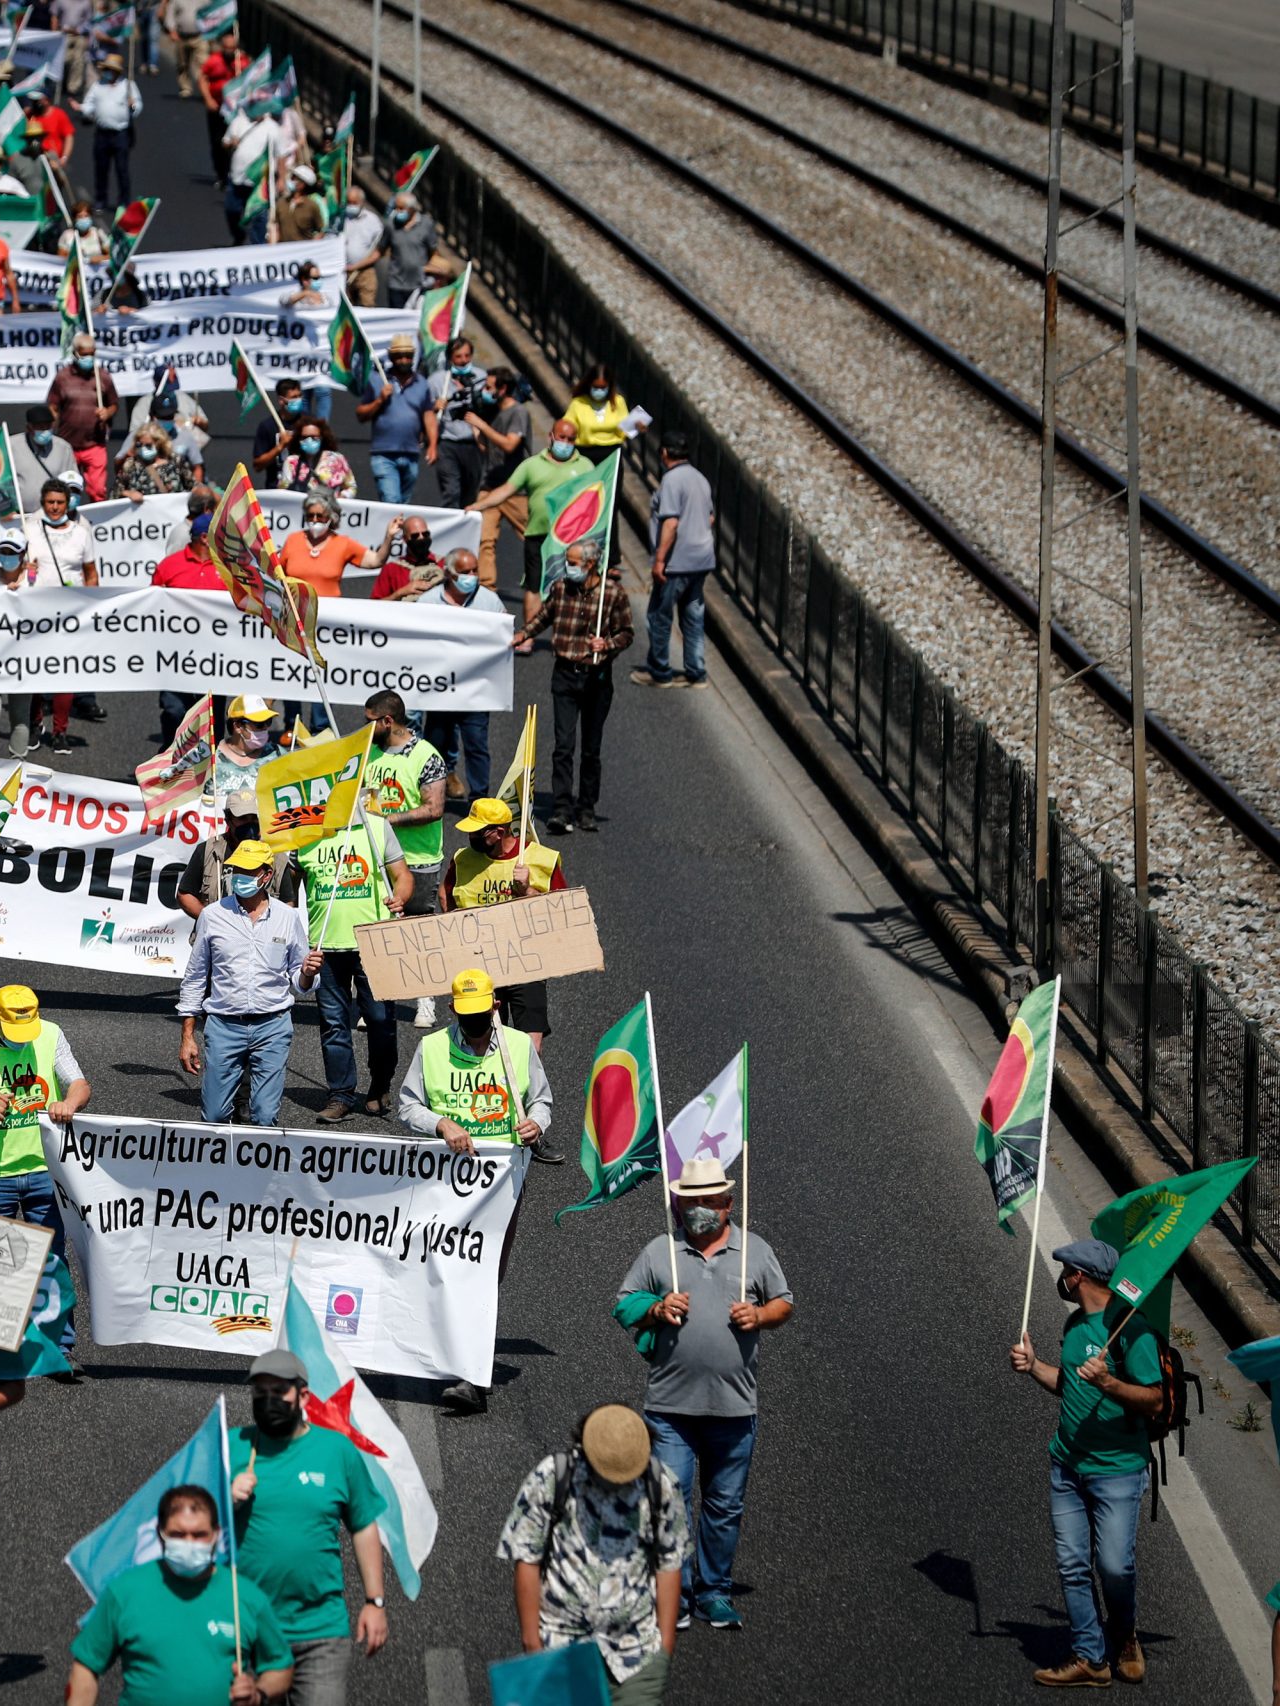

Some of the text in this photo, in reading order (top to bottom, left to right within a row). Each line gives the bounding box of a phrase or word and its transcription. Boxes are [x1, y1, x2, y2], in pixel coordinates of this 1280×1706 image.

[179, 267, 219, 290] DOS
[227, 258, 308, 286] BALDIO
[187, 316, 306, 343] PRODUÇÃO
[93, 519, 173, 544] ender
[91, 607, 201, 635] técnico
[211, 618, 229, 638] e
[126, 654, 145, 674] e
[156, 650, 259, 680] Médias
[270, 657, 457, 694] Explorações!
[140, 809, 229, 846] HIST
[318, 844, 357, 864] UAGA
[127, 935, 176, 946] AGRARIAS
[359, 909, 497, 958] TENEMOS
[134, 945, 160, 959] UAGA
[399, 950, 448, 988] NO
[450, 1071, 498, 1093] UAGA
[445, 1093, 503, 1109] COAG
[60, 1122, 227, 1173] Agricultura
[236, 1139, 291, 1173] con
[99, 1196, 144, 1234] una
[154, 1188, 219, 1230] PAC
[227, 1197, 400, 1248] profesional
[399, 1220, 421, 1261] y
[420, 1213, 484, 1264] justa
[176, 1252, 251, 1289] UAGA
[151, 1285, 269, 1318] COAG
